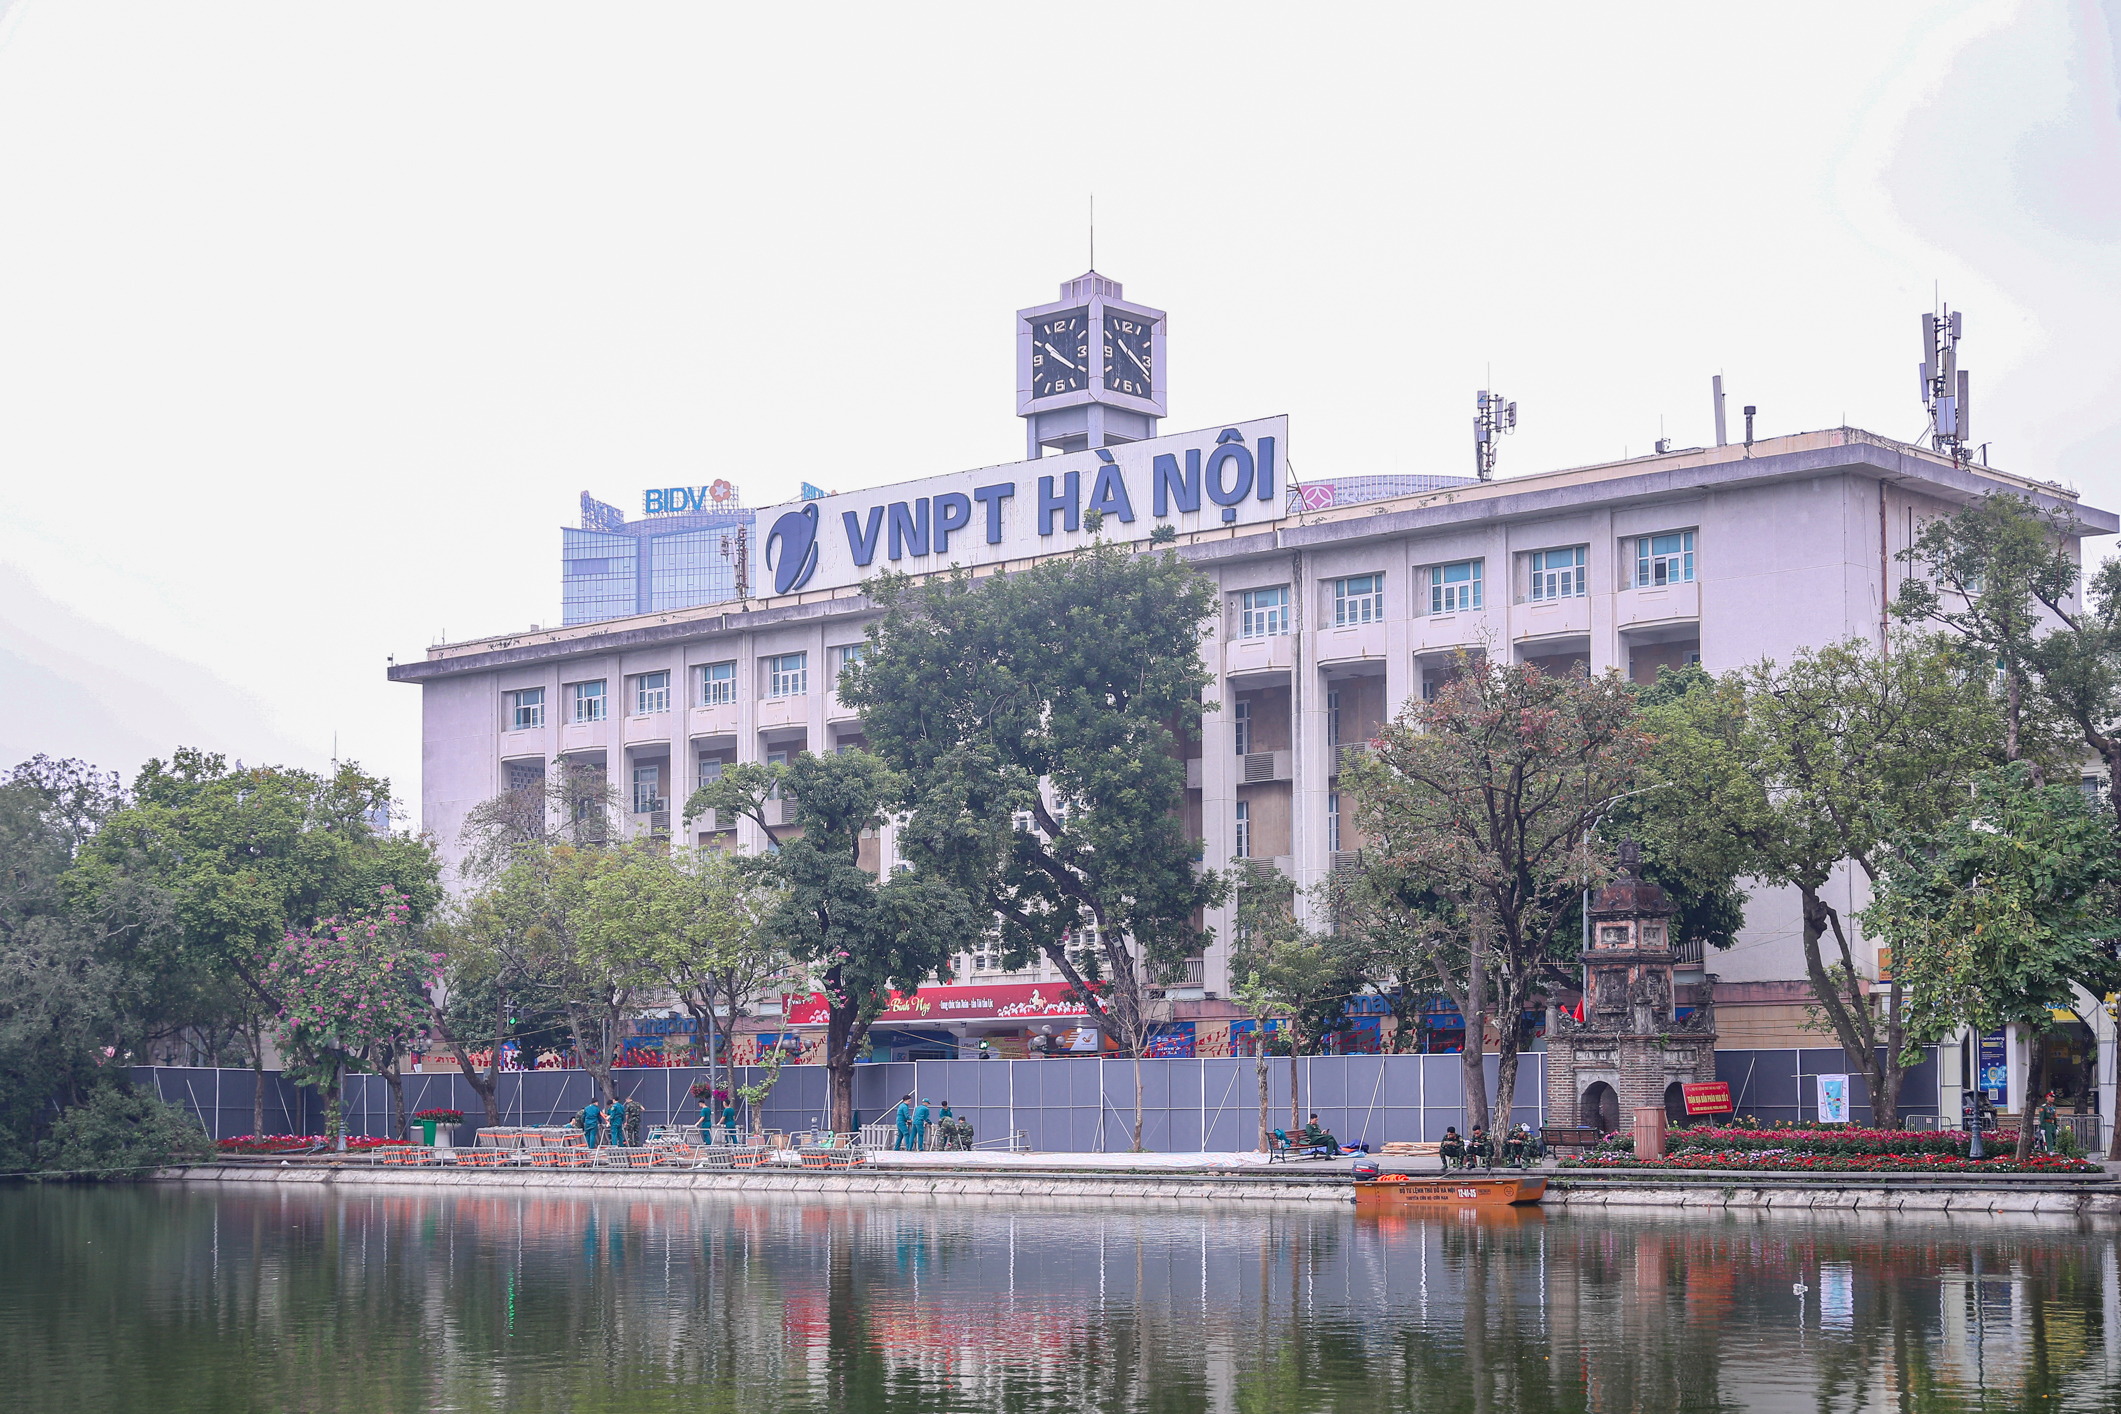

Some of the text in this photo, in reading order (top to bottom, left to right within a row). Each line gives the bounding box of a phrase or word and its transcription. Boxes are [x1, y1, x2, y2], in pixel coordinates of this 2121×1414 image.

[1054, 320, 1066, 333] 12
[1122, 320, 1133, 334] 12
[1077, 345, 1087, 359] 3
[1104, 345, 1113, 358] 9
[1033, 354, 1044, 367] 9
[1142, 355, 1151, 368] 3
[1055, 379, 1066, 393] 6
[1123, 380, 1133, 393] 6
[803, 481, 830, 501] BID
[842, 427, 1276, 567] VNPT HÀ NỘI
[645, 485, 709, 513] BIDV
[896, 1052, 907, 1061] 5G
